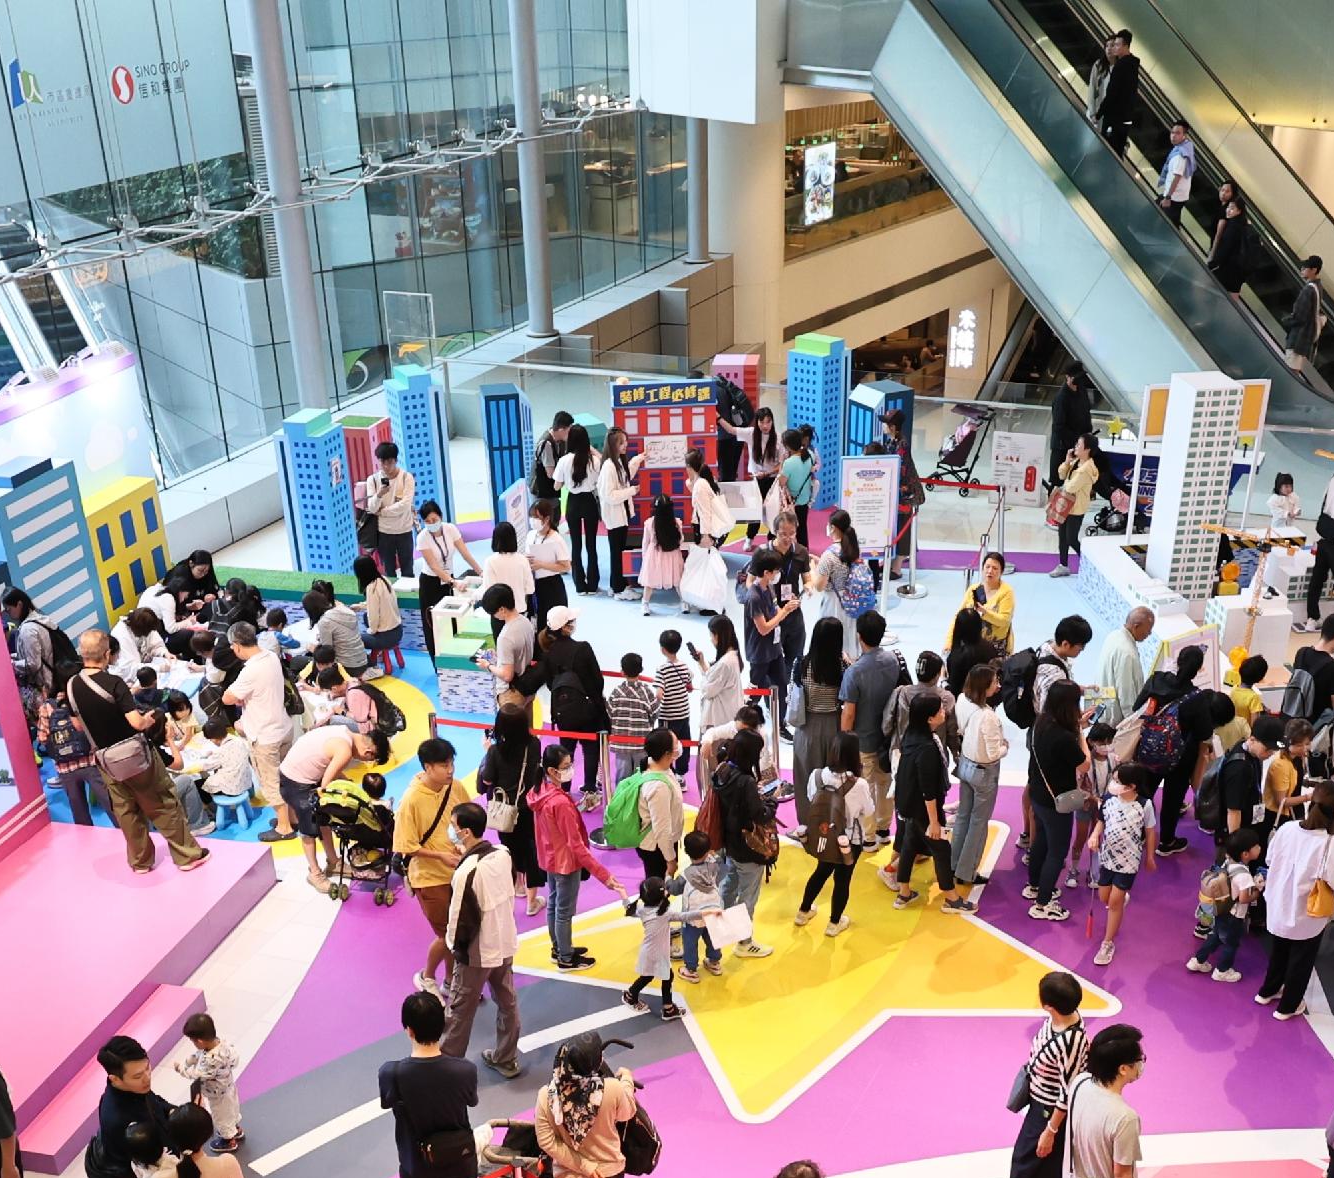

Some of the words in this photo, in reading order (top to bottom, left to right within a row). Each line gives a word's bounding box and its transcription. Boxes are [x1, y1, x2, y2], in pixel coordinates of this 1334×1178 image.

[134, 64, 158, 79] SINO
[158, 59, 190, 76] GROUP
[137, 76, 185, 99] 信和集團
